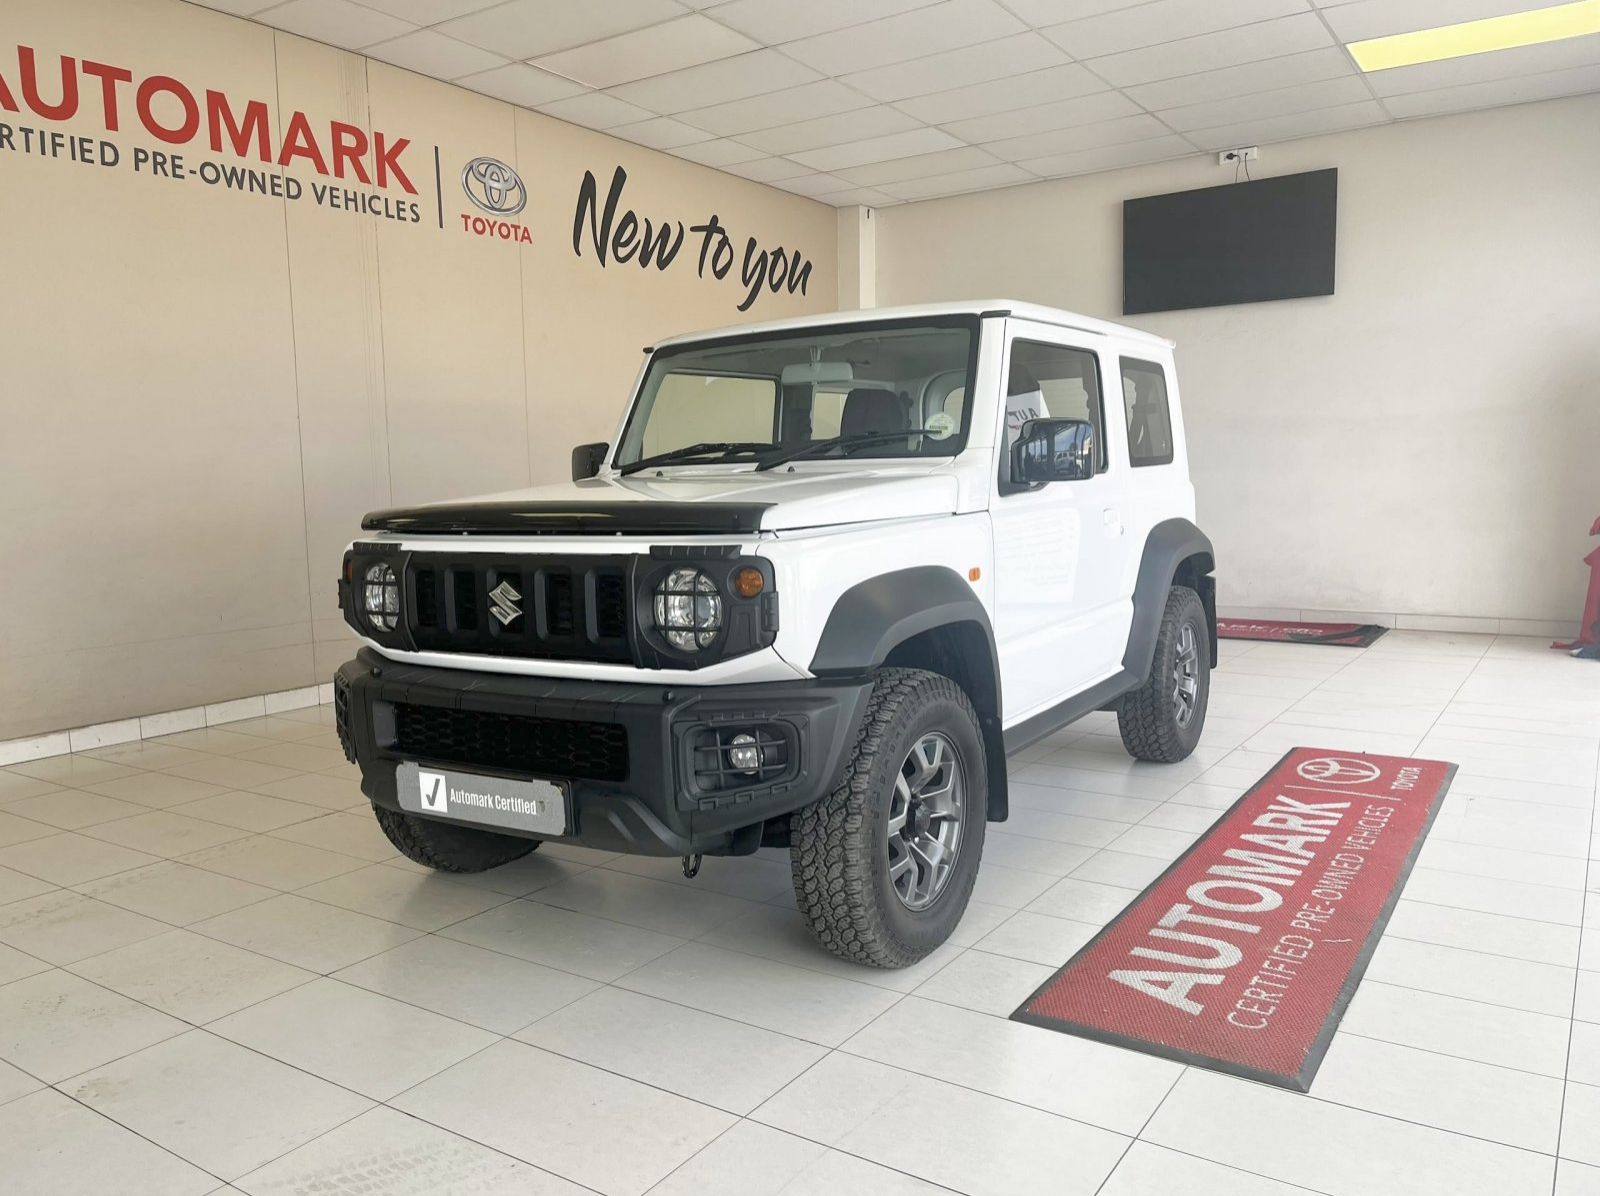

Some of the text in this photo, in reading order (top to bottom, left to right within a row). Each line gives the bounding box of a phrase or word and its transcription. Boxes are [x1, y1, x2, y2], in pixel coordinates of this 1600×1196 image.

[134, 147, 302, 200] PRE-OWNED
[312, 182, 420, 223] VEHICLES
[461, 214, 532, 244] TOYOTA
[573, 165, 812, 312] New to you
[450, 786, 537, 815] Automark Certified
[1390, 766, 1423, 791] TOYOTA
[1107, 794, 1351, 1015] AUTOMARK
[1227, 804, 1395, 1029] CERTIFIED PRE-OWNED VEHICLES
